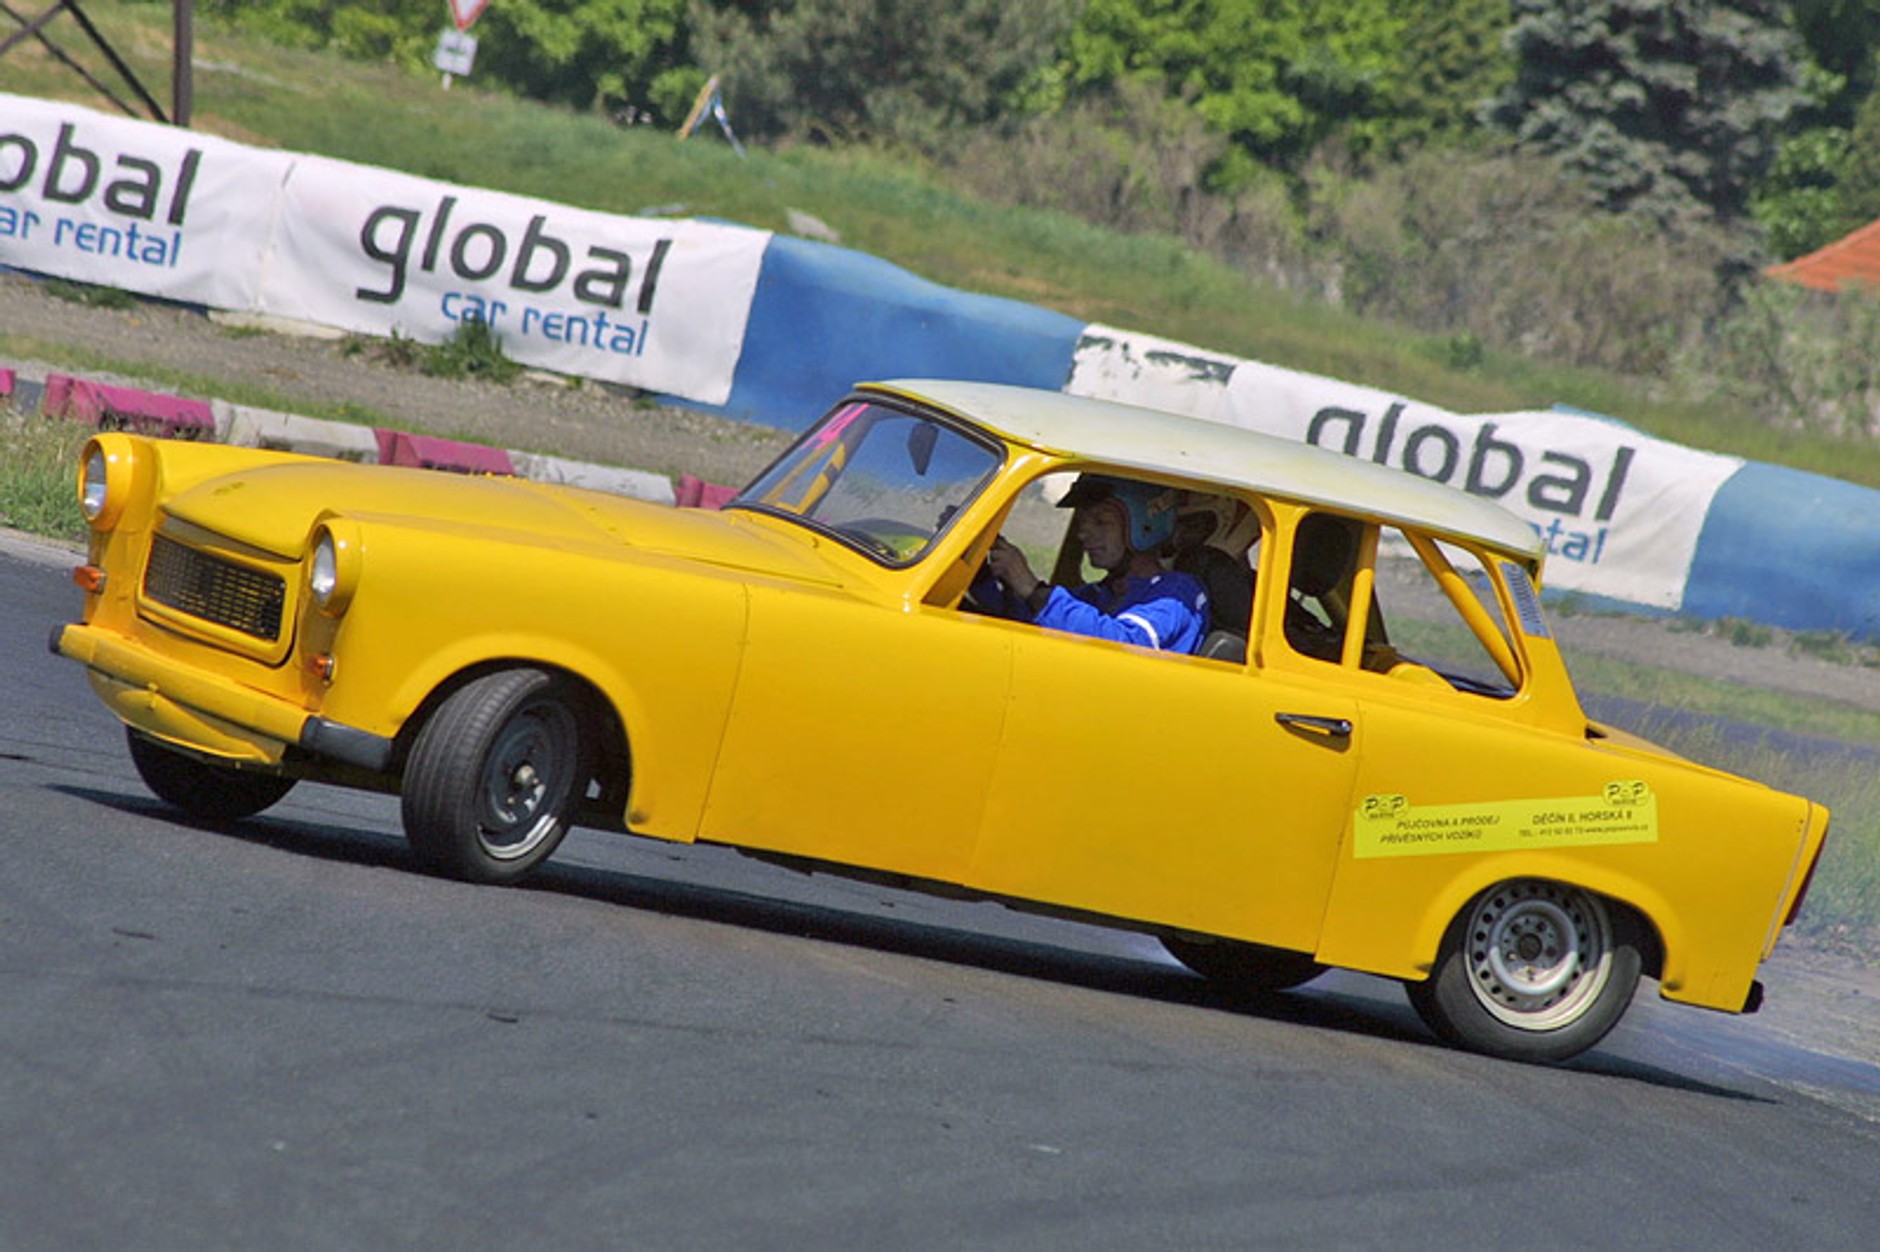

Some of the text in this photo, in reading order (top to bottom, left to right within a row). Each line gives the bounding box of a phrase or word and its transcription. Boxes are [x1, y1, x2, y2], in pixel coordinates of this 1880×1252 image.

[54, 217, 182, 267] rental
[355, 196, 673, 313] global
[441, 291, 648, 357] car rental
